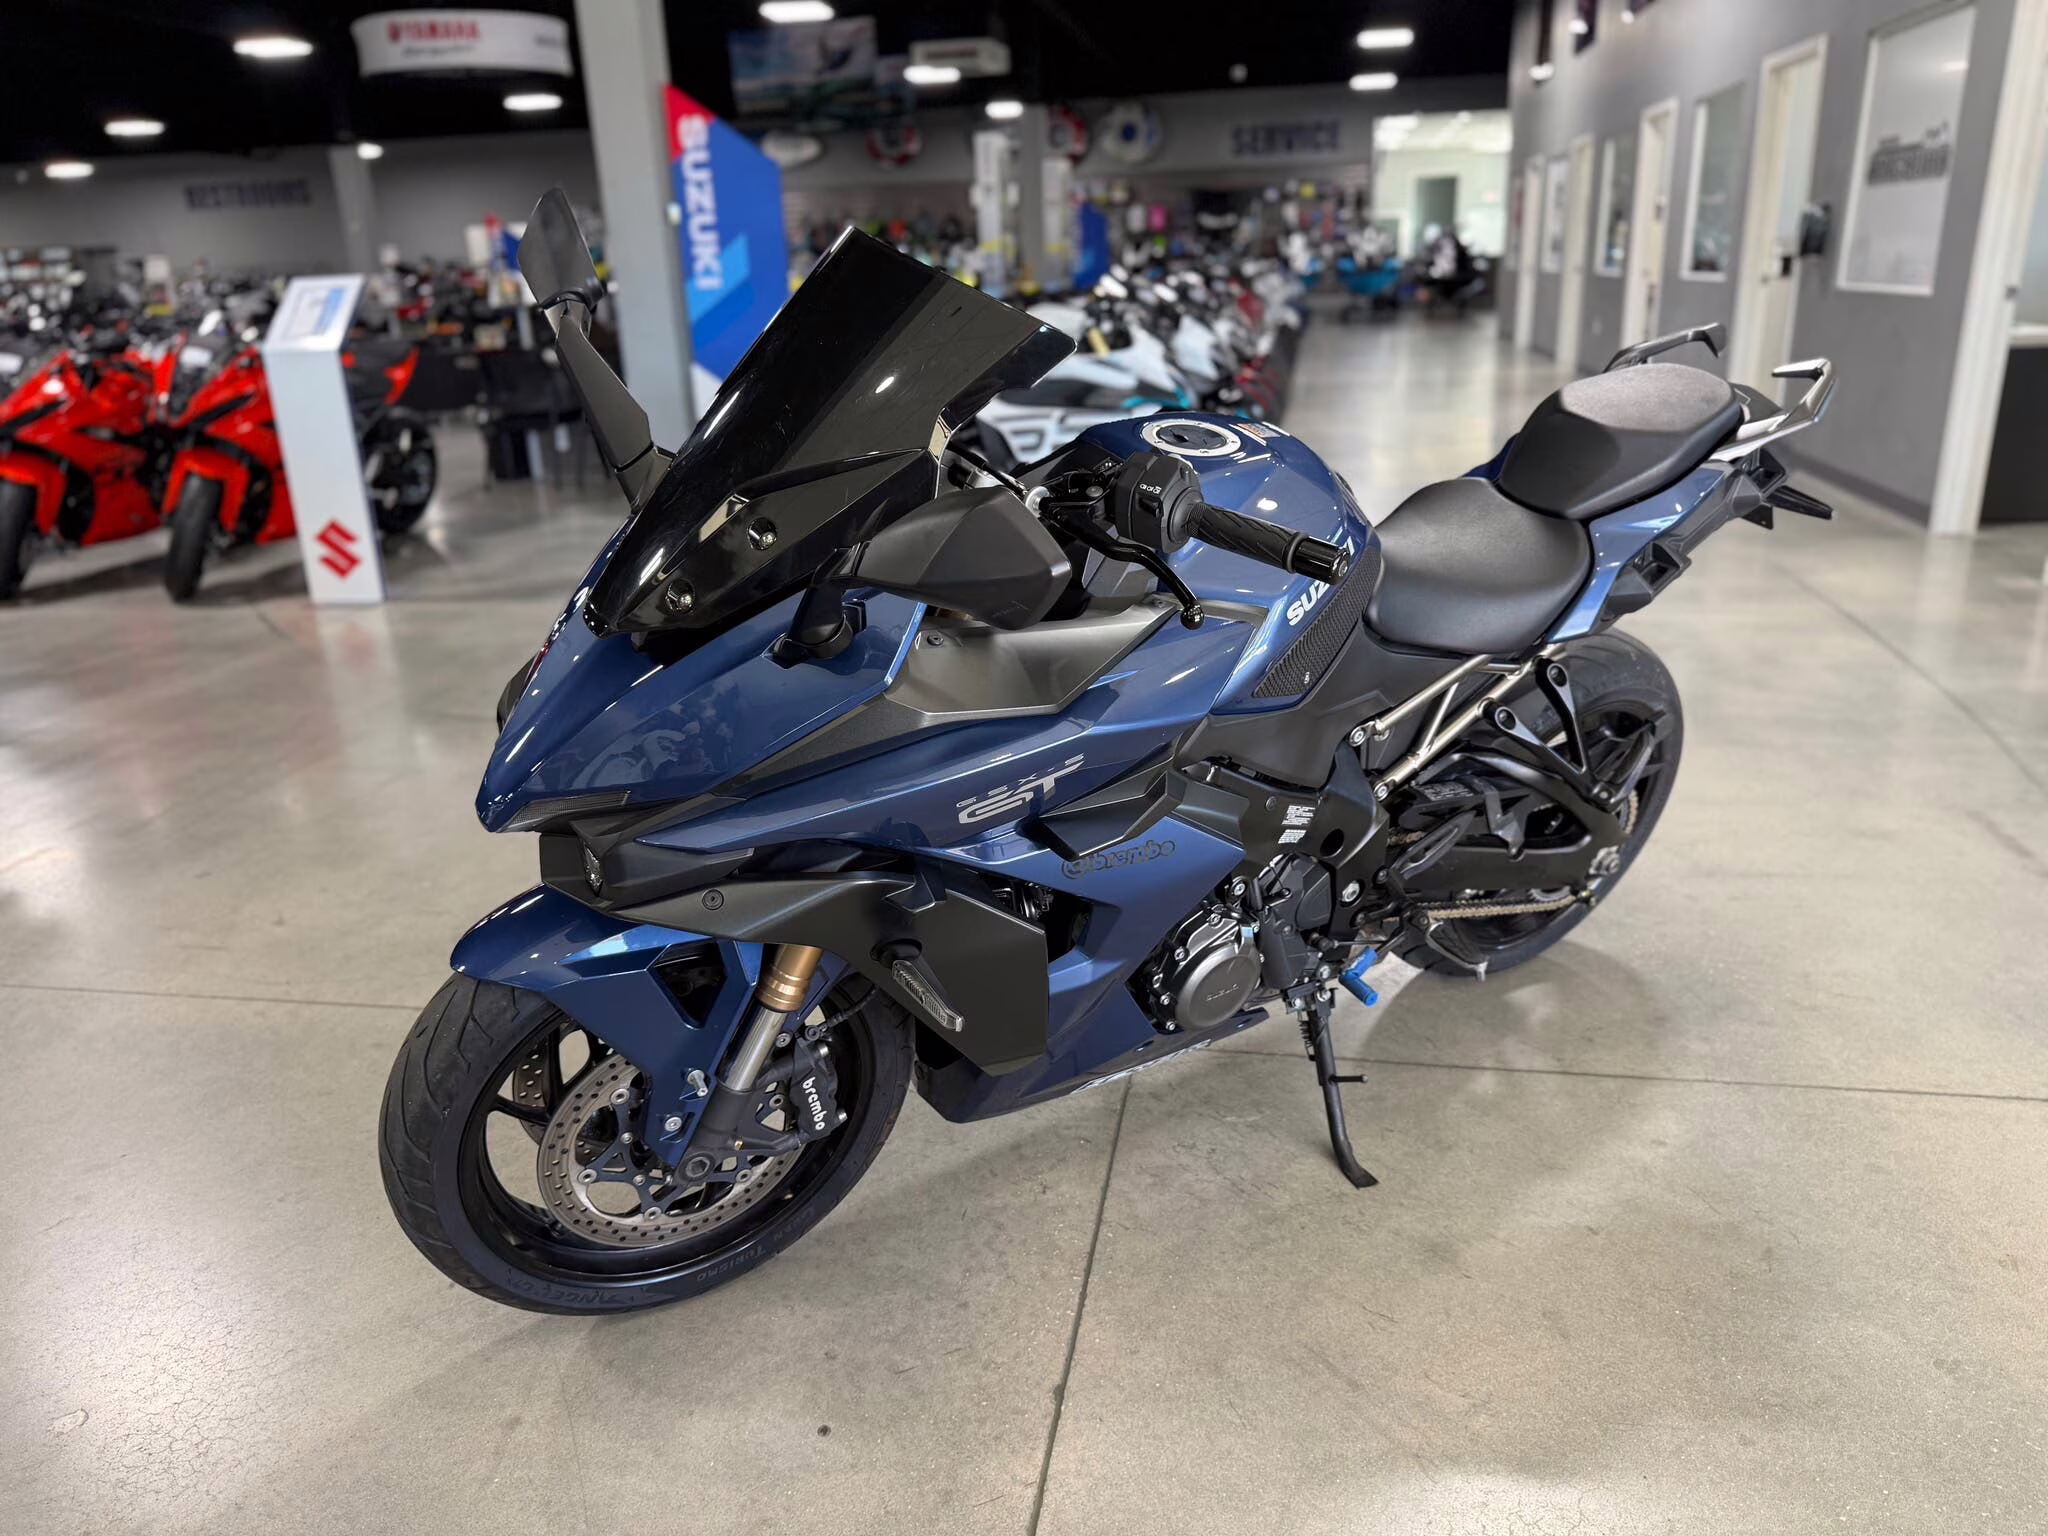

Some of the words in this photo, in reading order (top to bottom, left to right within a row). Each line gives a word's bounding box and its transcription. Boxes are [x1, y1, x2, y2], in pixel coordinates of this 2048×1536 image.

[1231, 120, 1342, 155] SERVICE
[677, 113, 725, 291] SUZUKI
[802, 1076, 827, 1131] brembo
